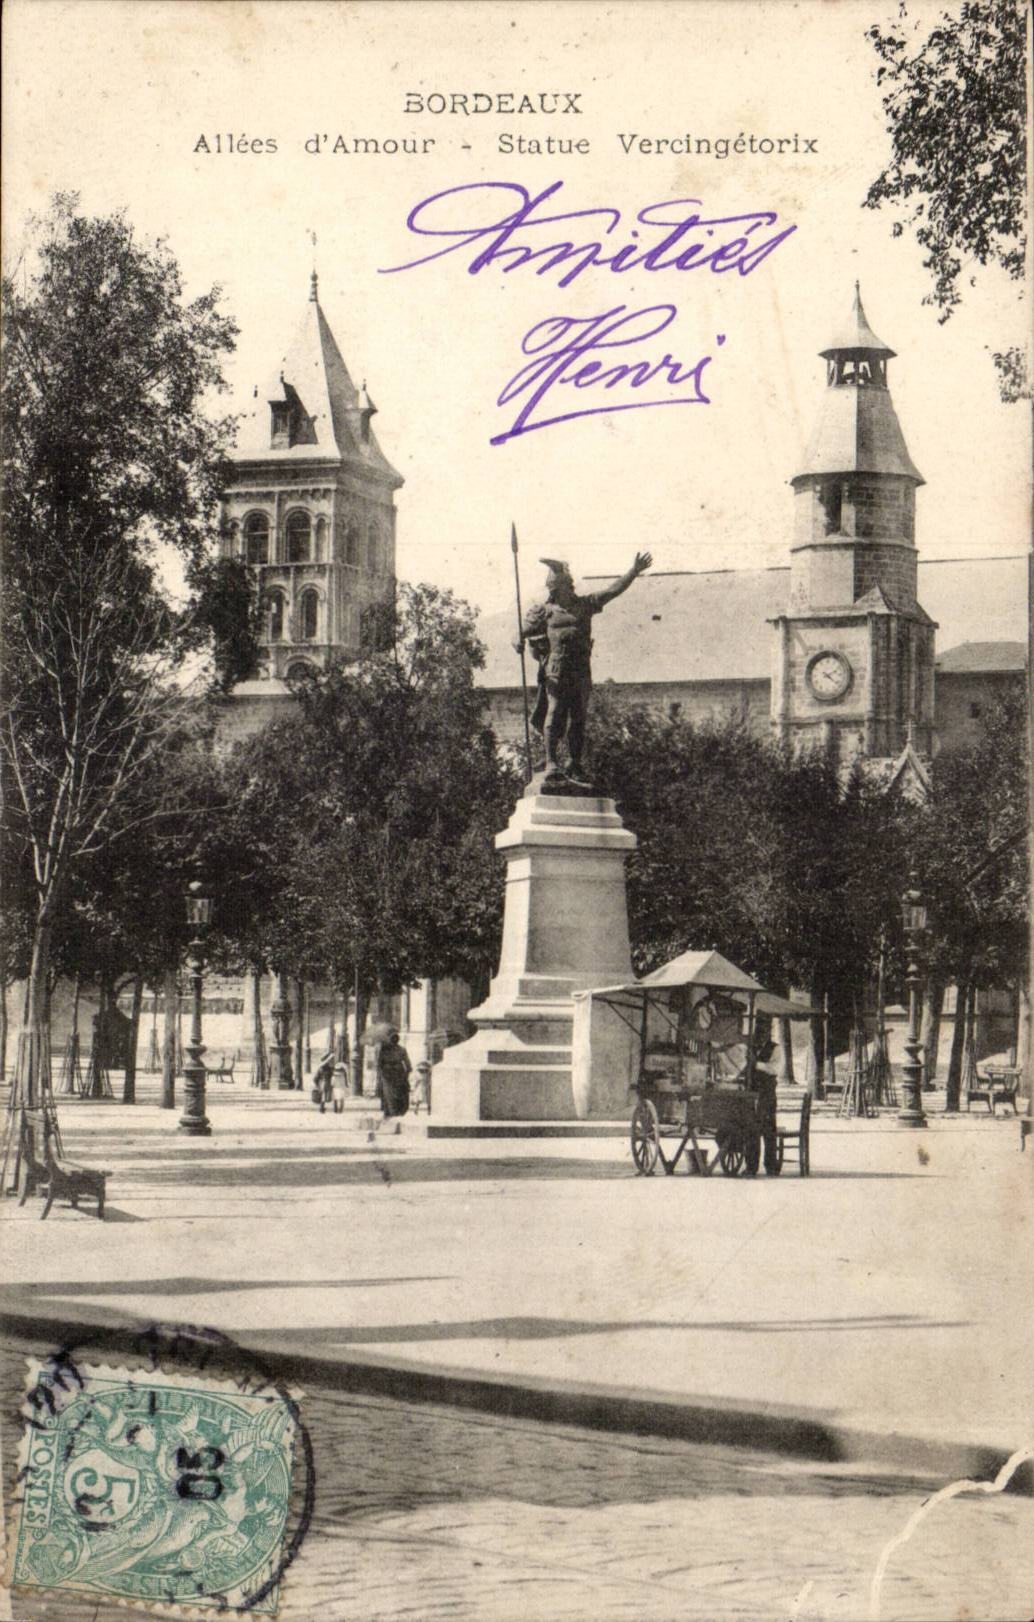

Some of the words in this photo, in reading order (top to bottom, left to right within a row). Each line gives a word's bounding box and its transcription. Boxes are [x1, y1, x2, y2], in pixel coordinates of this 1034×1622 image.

[379, 180, 798, 289] Amitiés
[489, 303, 727, 447] Henri
[26, 1431, 57, 1523] POSTES
